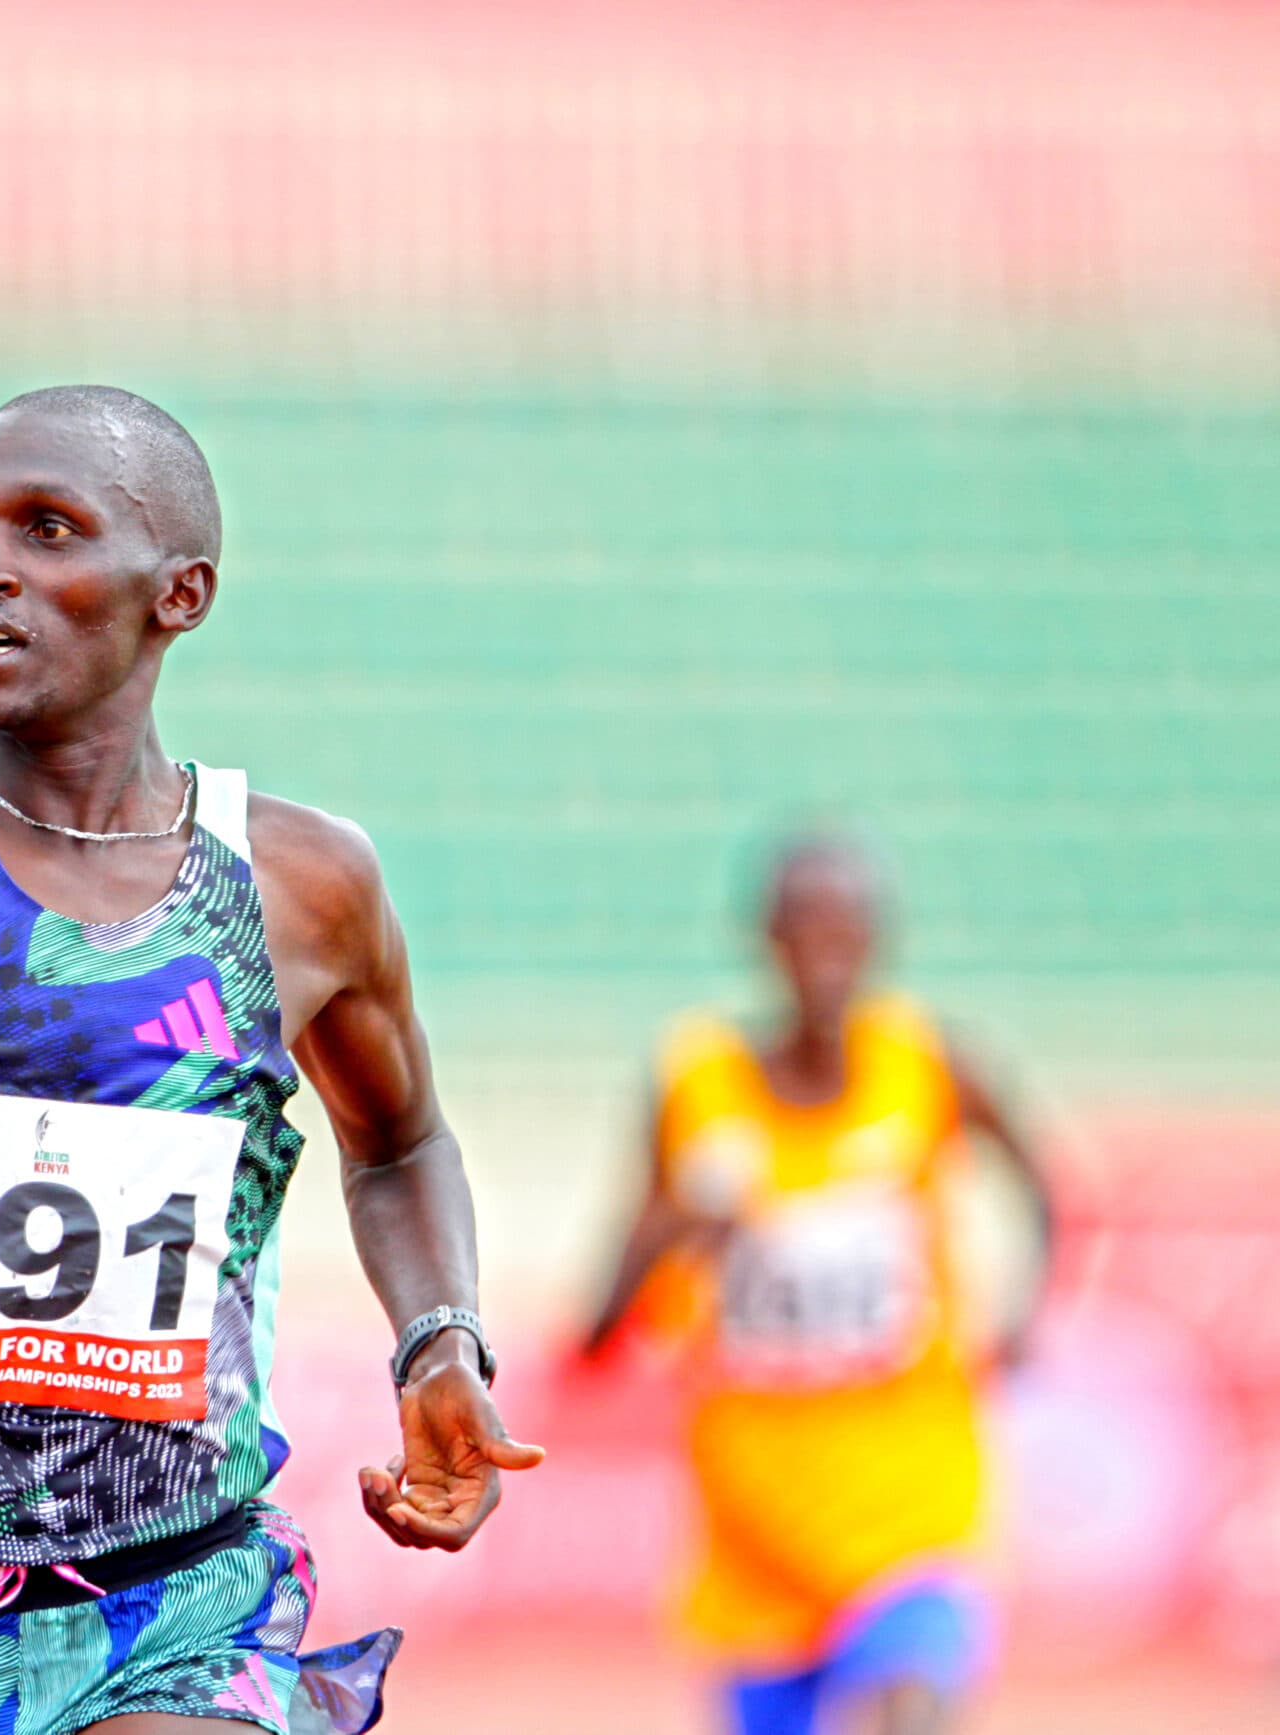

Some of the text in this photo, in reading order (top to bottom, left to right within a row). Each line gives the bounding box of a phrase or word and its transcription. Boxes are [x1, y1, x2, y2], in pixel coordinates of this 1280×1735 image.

[34, 1162, 70, 1175] KENYA
[0, 1336, 65, 1364] FOR
[75, 1342, 183, 1375] WORLD
[146, 1382, 183, 1399] 2023
